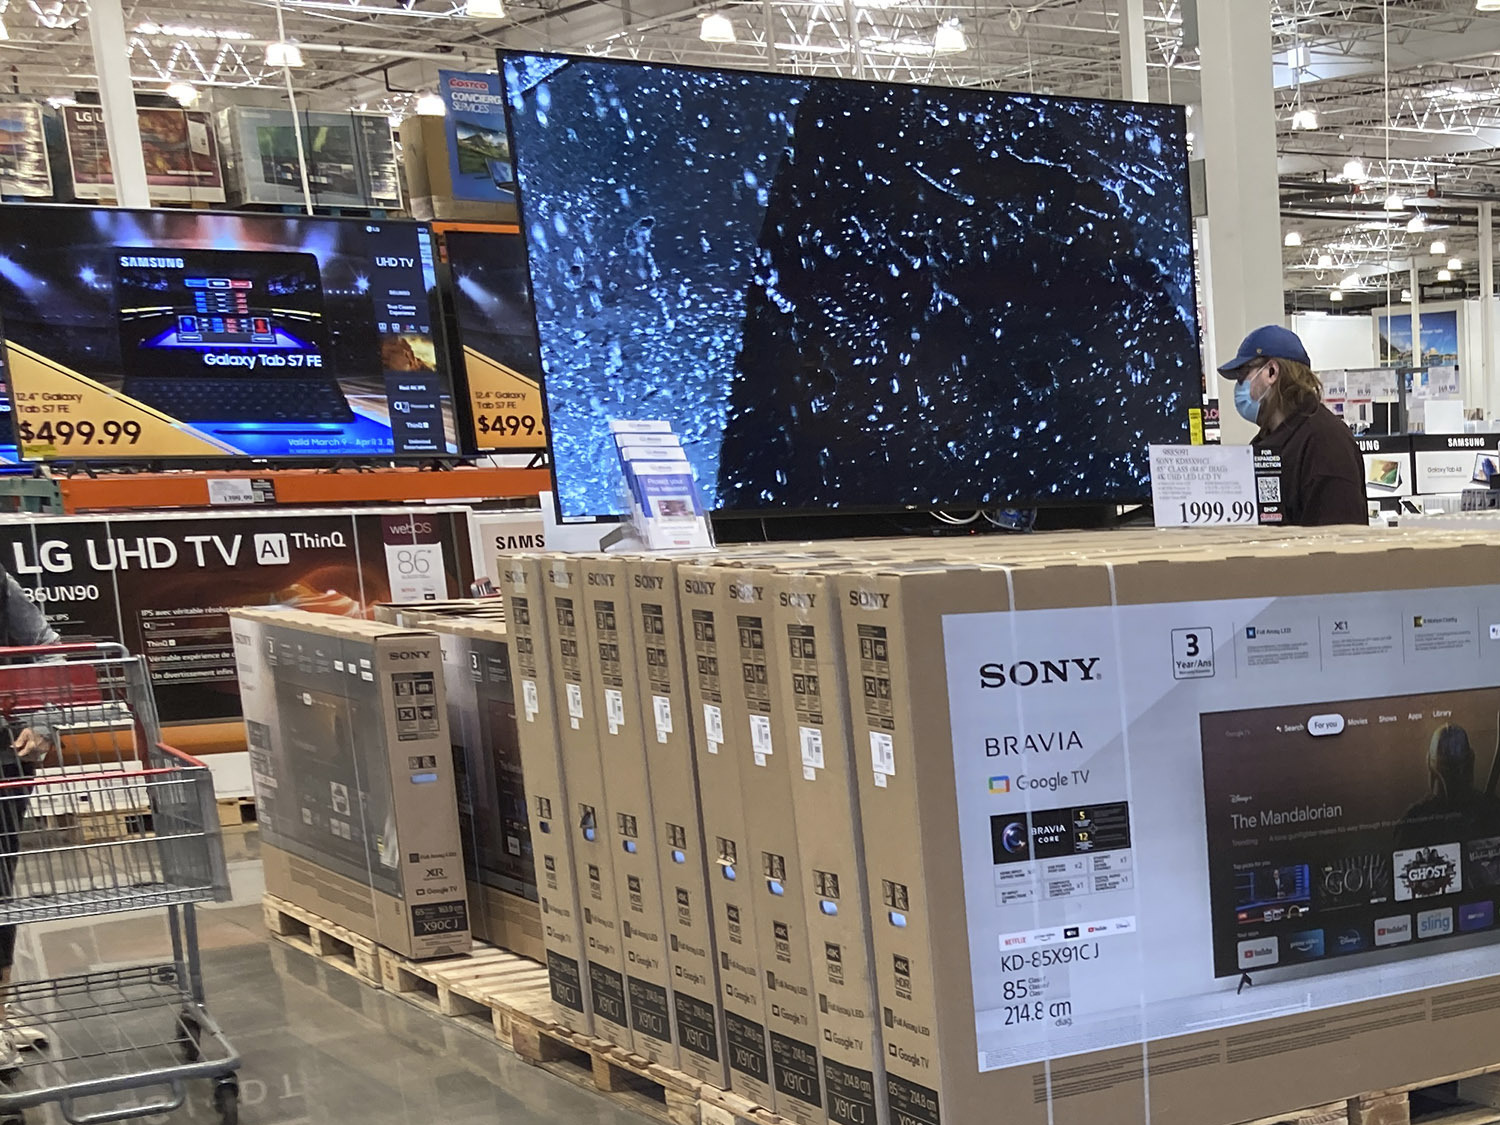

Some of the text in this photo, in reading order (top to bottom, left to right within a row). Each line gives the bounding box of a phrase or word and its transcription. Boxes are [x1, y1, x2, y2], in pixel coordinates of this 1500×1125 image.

[450, 79, 488, 90] COSTCO
[452, 102, 490, 114] SERVICES
[75, 112, 93, 122] LG
[120, 256, 185, 269] SAMSUNG
[375, 256, 414, 268] UHD TV
[203, 353, 323, 370] Galaxy Tab S7 FE
[41, 392, 83, 404] Galaxy
[495, 391, 527, 401] Galaxy
[17, 404, 40, 414] Tab
[19, 420, 142, 446] $499.99
[311, 438, 337, 447] March
[1447, 437, 1485, 448] SAMSUNG
[1168, 465, 1189, 473] CLASS
[1427, 466, 1446, 474] Galaxy
[1179, 500, 1255, 524] 1999.99
[389, 522, 432, 536] webOS
[495, 534, 545, 550] SAMS
[12, 531, 347, 575] LG UHD TV AI ThinQ
[587, 573, 616, 588] SONY
[634, 575, 664, 590] SONY
[684, 579, 716, 596] SONY
[849, 590, 890, 609] SONY
[1185, 633, 1200, 657] 3
[389, 650, 431, 661] SONY
[1175, 659, 1212, 670] Year/Ans
[979, 657, 1101, 689] SONY
[1284, 709, 1453, 733] Search For you Movies Shows Apps Library
[984, 730, 1084, 758] BRAVIA
[1016, 769, 1091, 793] Google TV
[1079, 811, 1086, 821] 5
[1231, 802, 1343, 830] The Mandalorian
[1031, 823, 1067, 837] BRAVIA
[1077, 832, 1089, 842] 12
[1037, 836, 1060, 845] CORE
[1232, 836, 1259, 847] Trending
[1074, 862, 1084, 871] x2
[1408, 864, 1448, 882] GHOST
[426, 885, 458, 896] Google TV
[1420, 915, 1451, 933] sling
[1004, 937, 1027, 946] NETFLIX
[1003, 979, 1028, 1001] 85
[1003, 1000, 1072, 1026] 214.8 cm
[916, 1024, 931, 1038] LED
[832, 1033, 854, 1050] Google
[897, 1048, 930, 1070] Google TV
